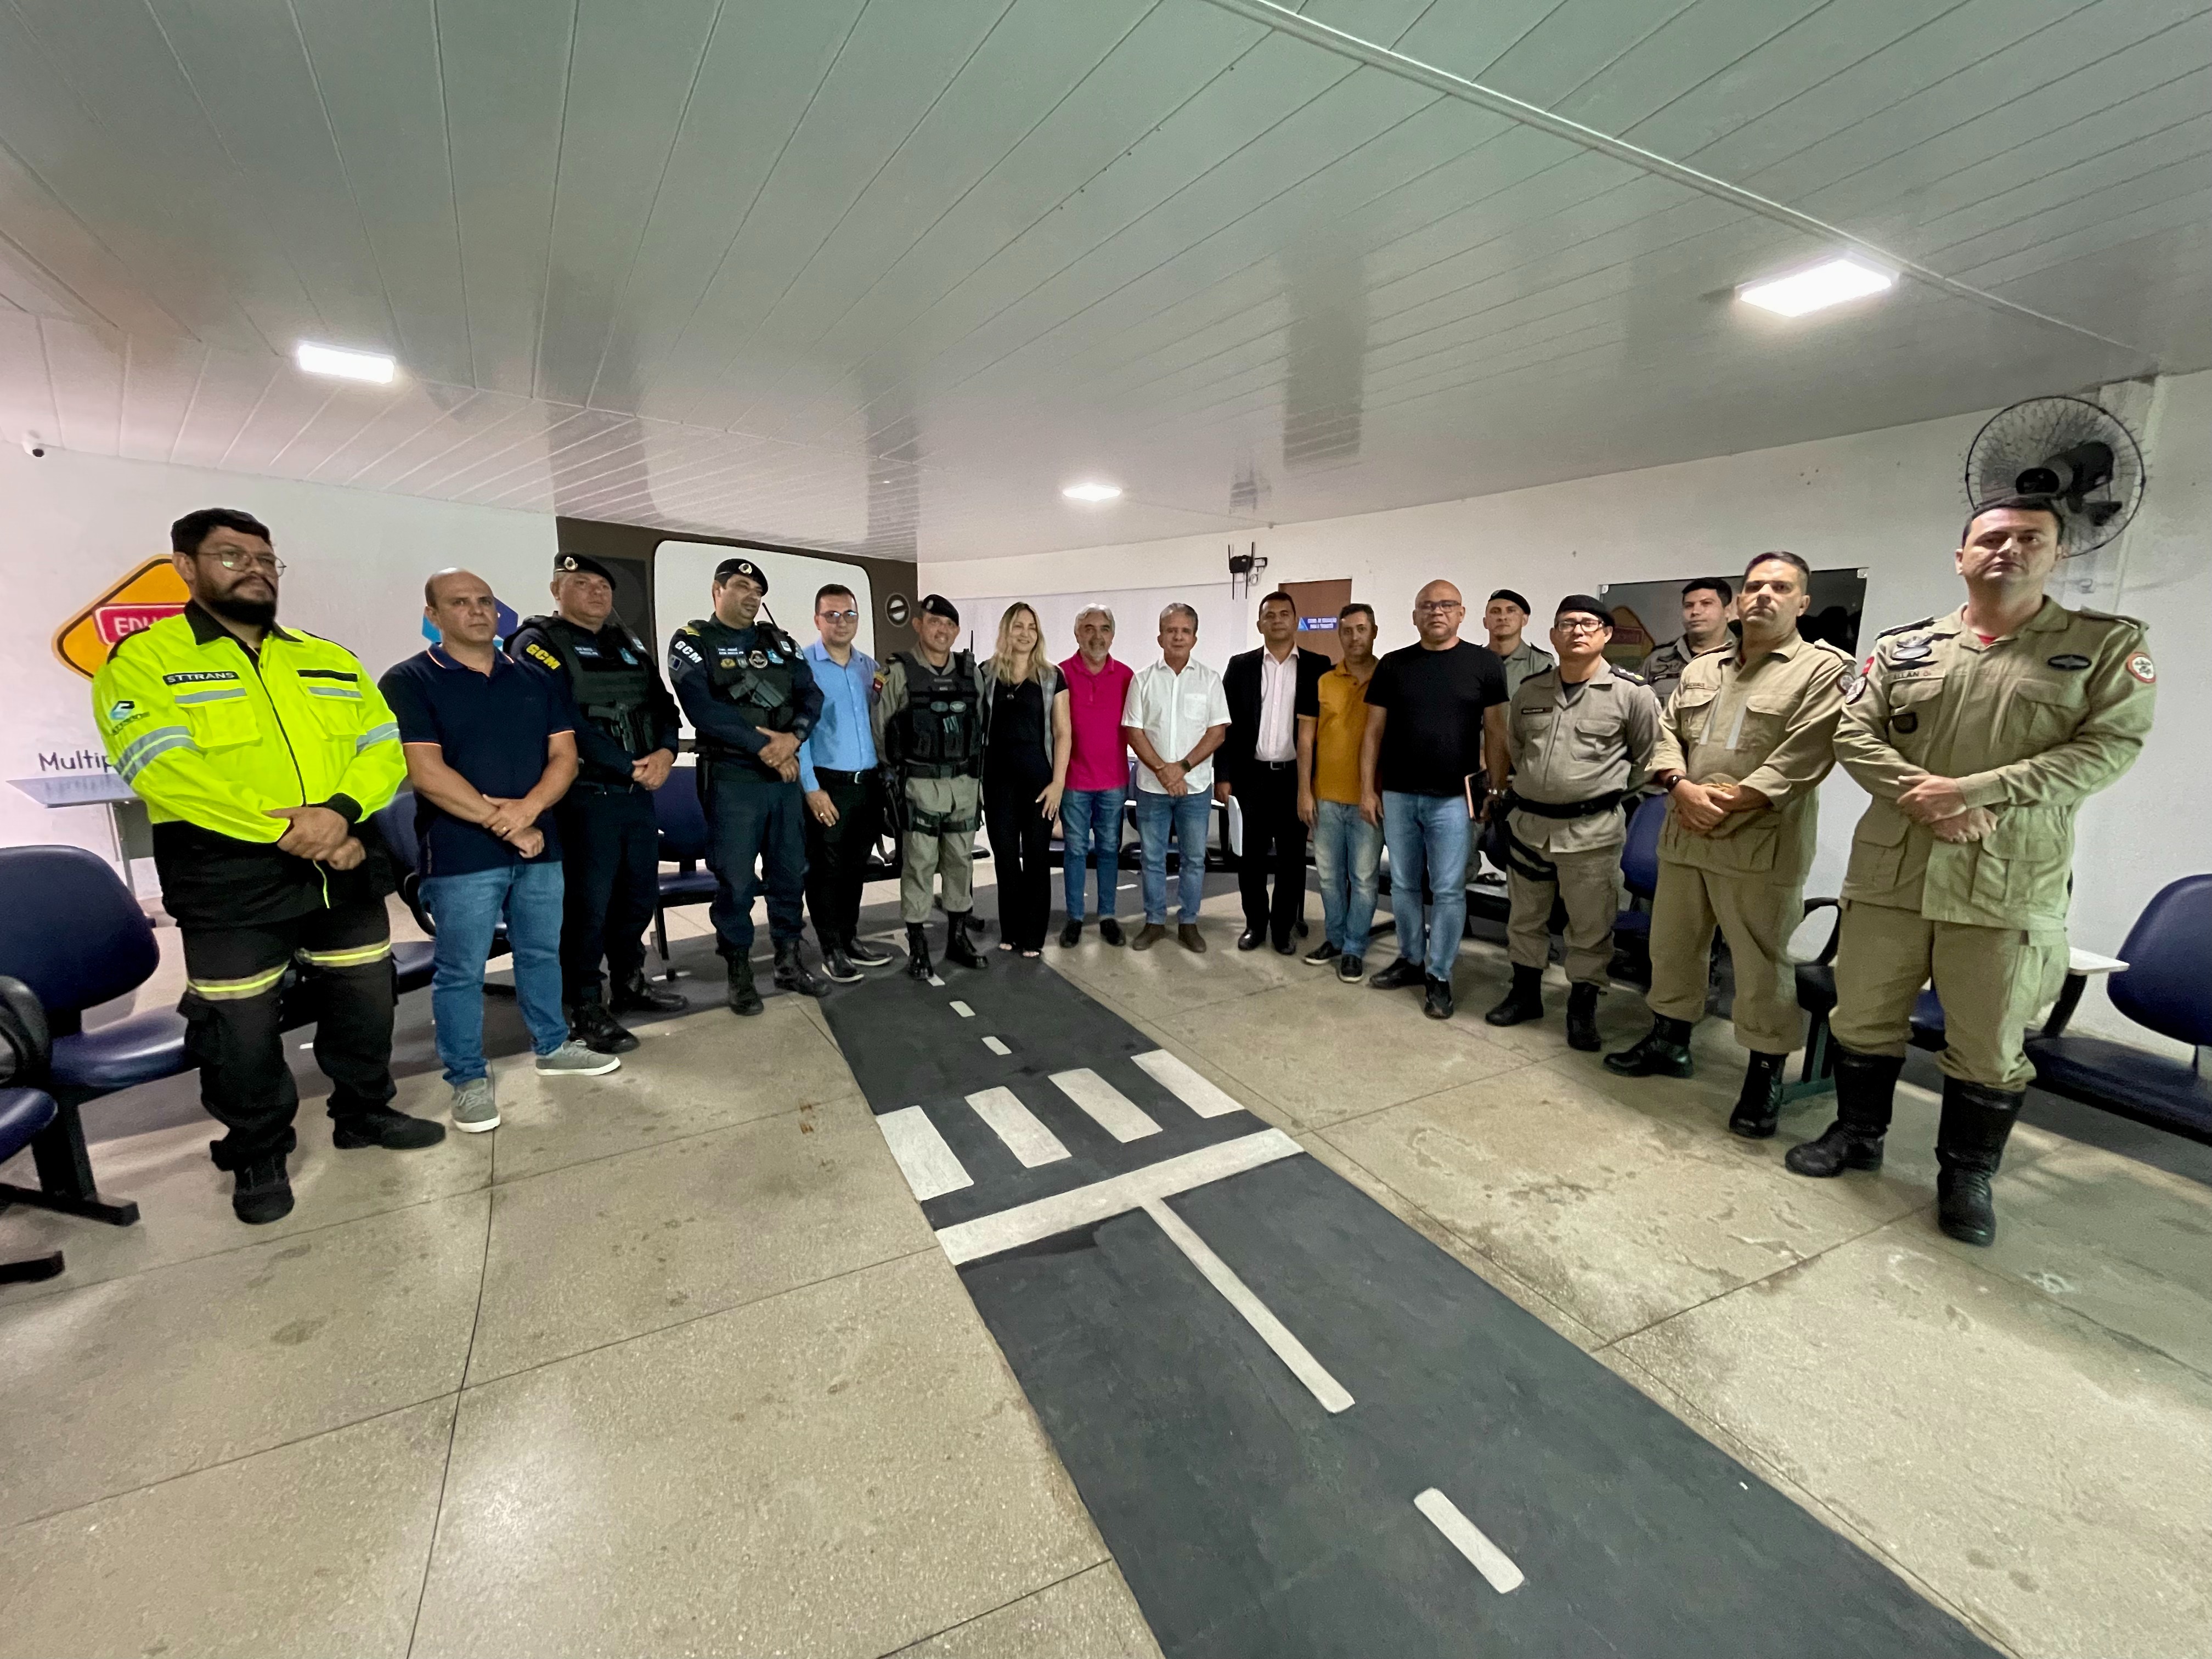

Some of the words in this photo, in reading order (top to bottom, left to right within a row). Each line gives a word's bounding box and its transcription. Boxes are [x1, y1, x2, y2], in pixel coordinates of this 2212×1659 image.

[526, 644, 561, 670] GCM
[675, 641, 702, 663] GCM
[167, 672, 235, 683] STTRANS
[38, 749, 112, 773] Multip
